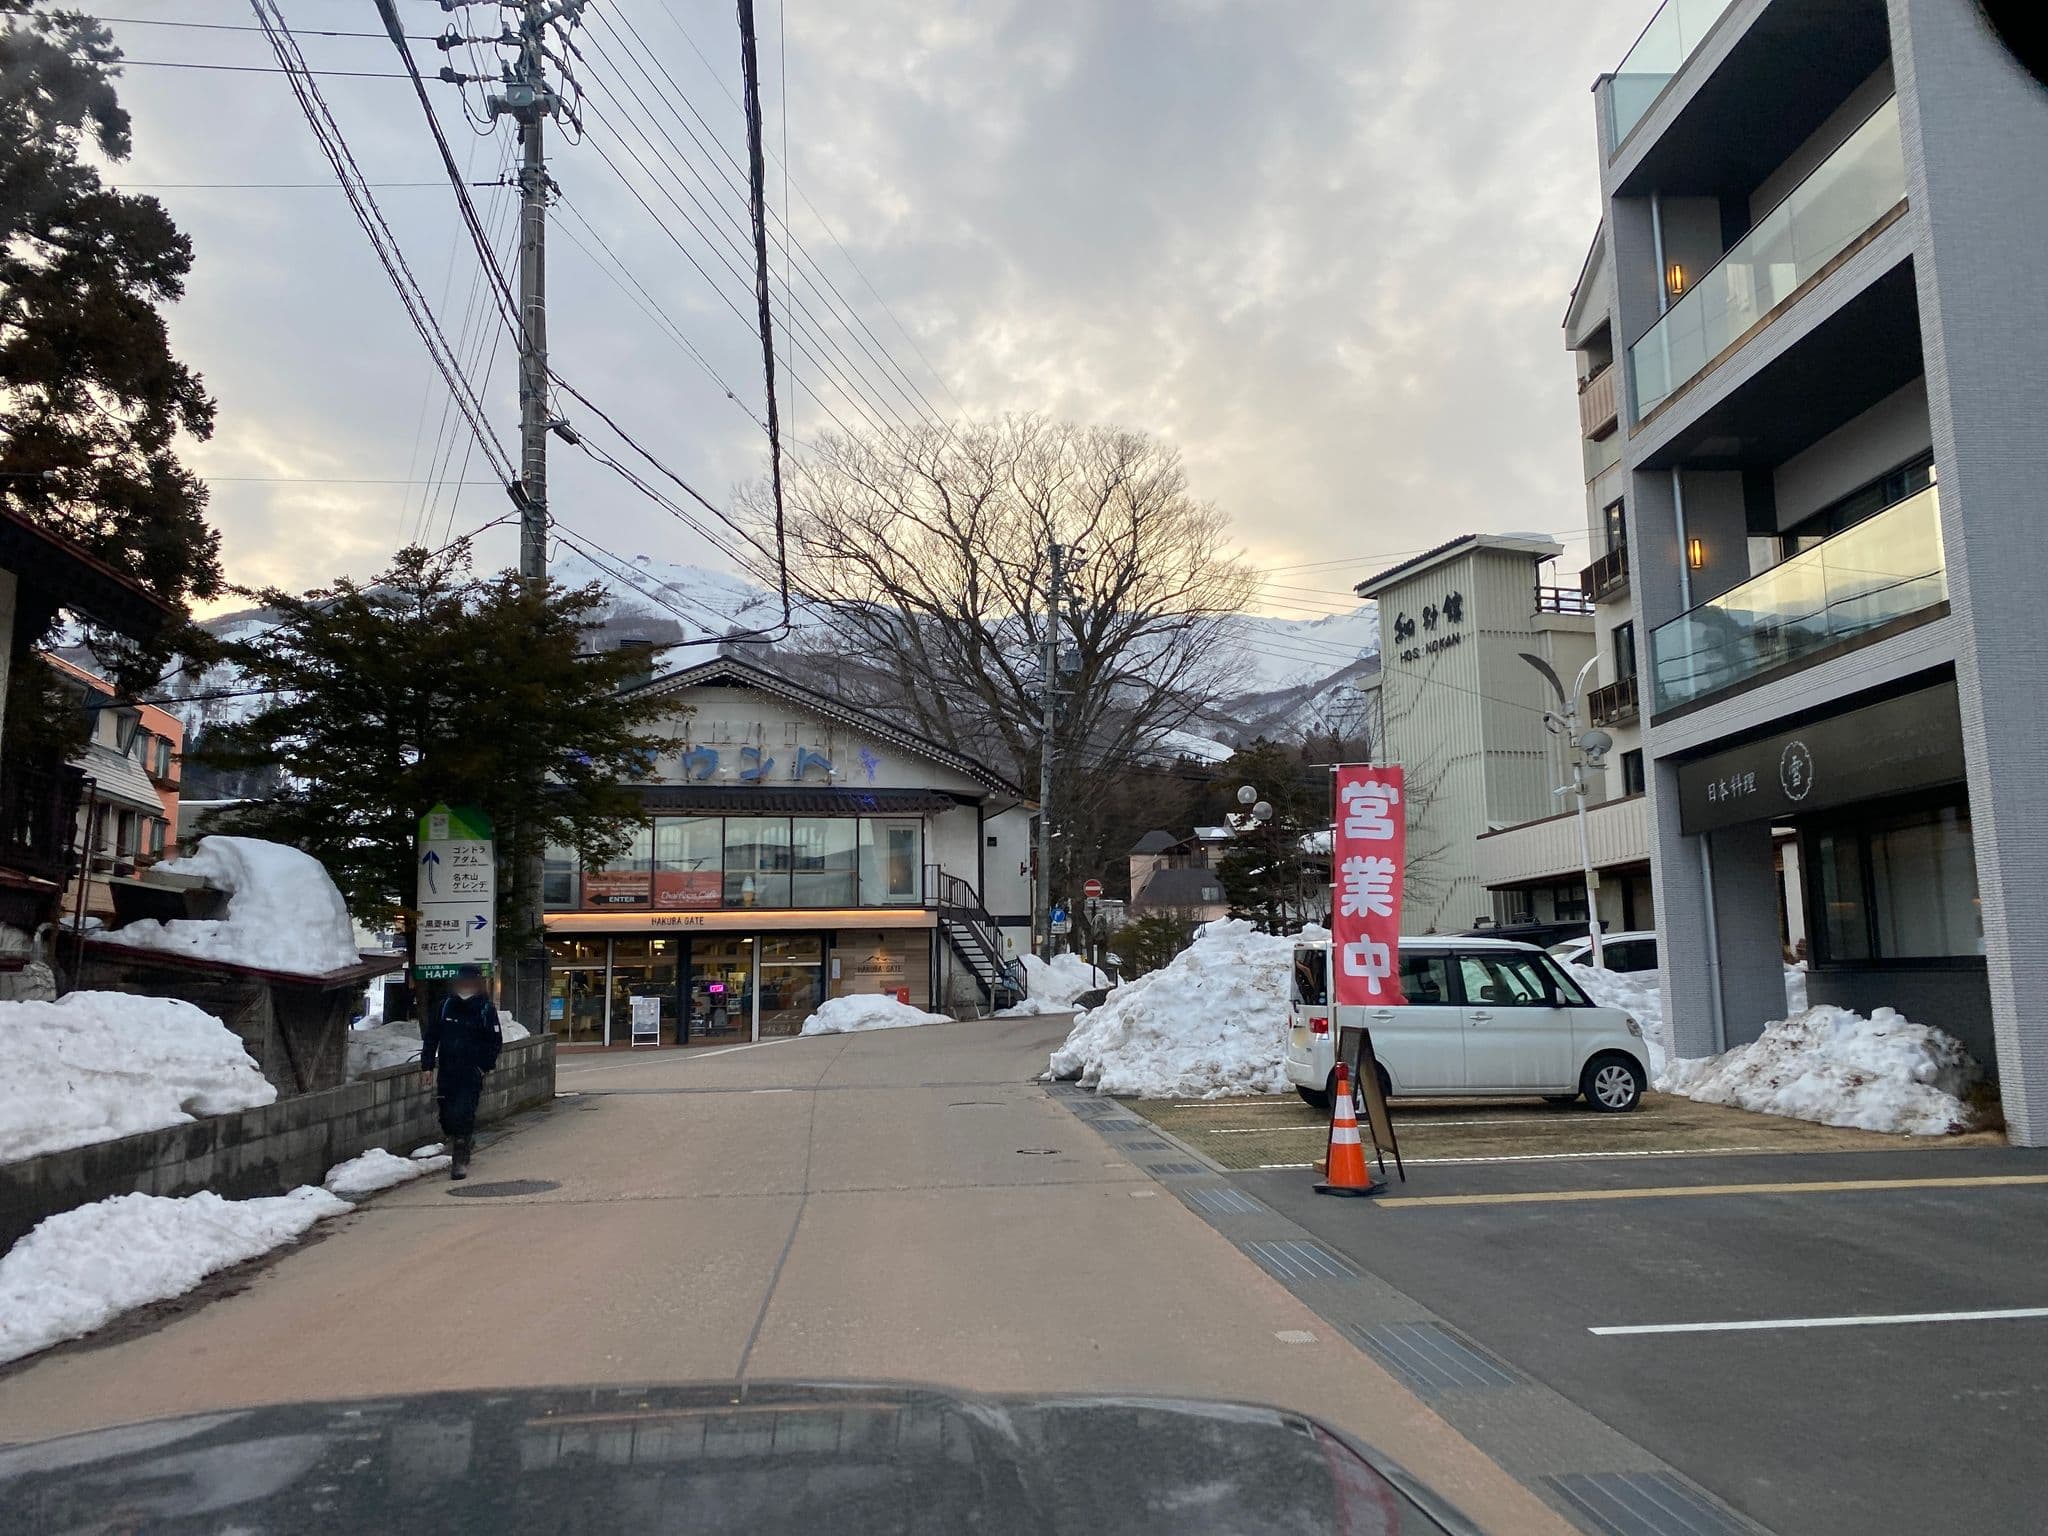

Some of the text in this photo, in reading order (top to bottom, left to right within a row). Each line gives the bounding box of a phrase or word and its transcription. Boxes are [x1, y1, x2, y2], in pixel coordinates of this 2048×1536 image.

[1708, 771, 1757, 802] 日本料理
[452, 846, 486, 855] ゴンドラ
[452, 855, 478, 863] アダム
[453, 873, 479, 882] 名木山
[452, 881, 487, 889] ゲレンデ
[1341, 780, 1399, 995] 営業中
[684, 916, 704, 926] GATE
[425, 969, 459, 979] HAPP
